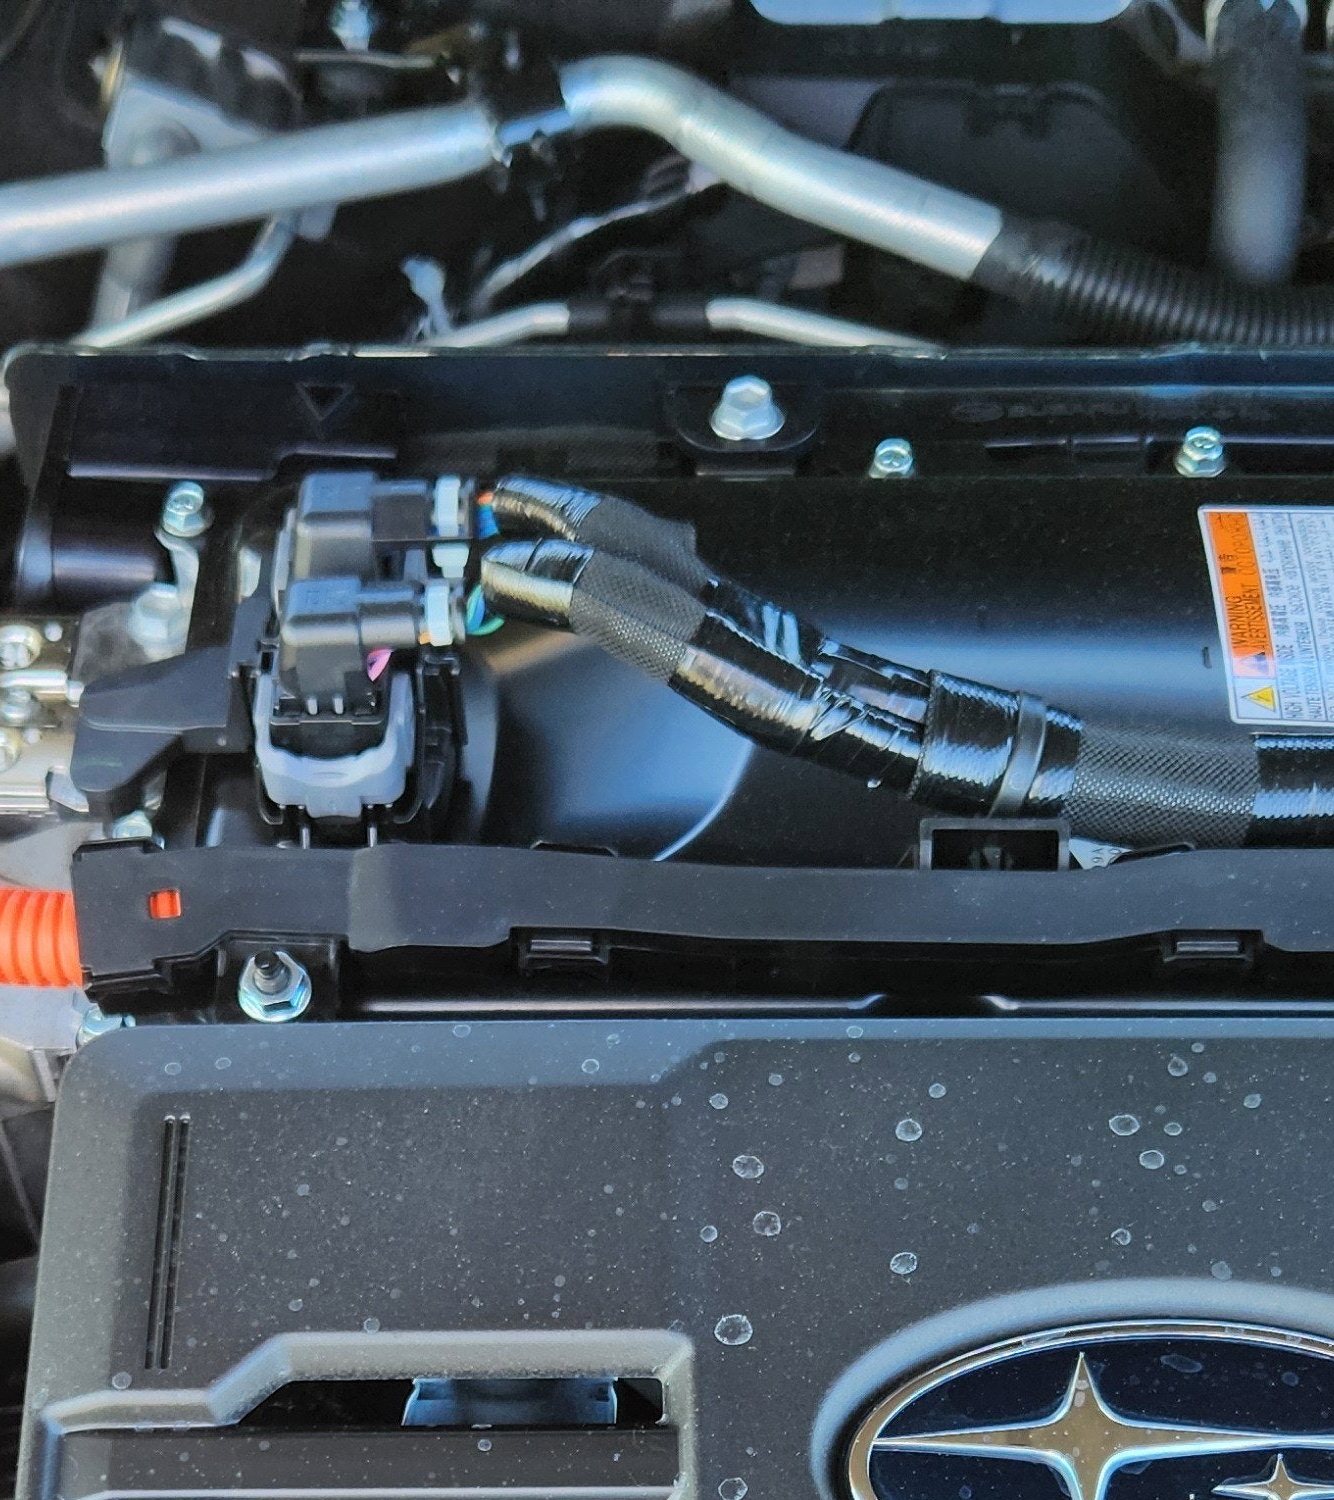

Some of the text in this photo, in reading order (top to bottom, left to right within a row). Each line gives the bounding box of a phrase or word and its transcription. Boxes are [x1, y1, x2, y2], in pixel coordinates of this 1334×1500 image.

[1225, 596, 1247, 648] WARNING
[1241, 583, 1268, 648] AVERTISSEMENT
[1279, 667, 1301, 699] VOLTAGE
[1283, 701, 1304, 719] HIGH
[1306, 697, 1323, 719] HAUTE
